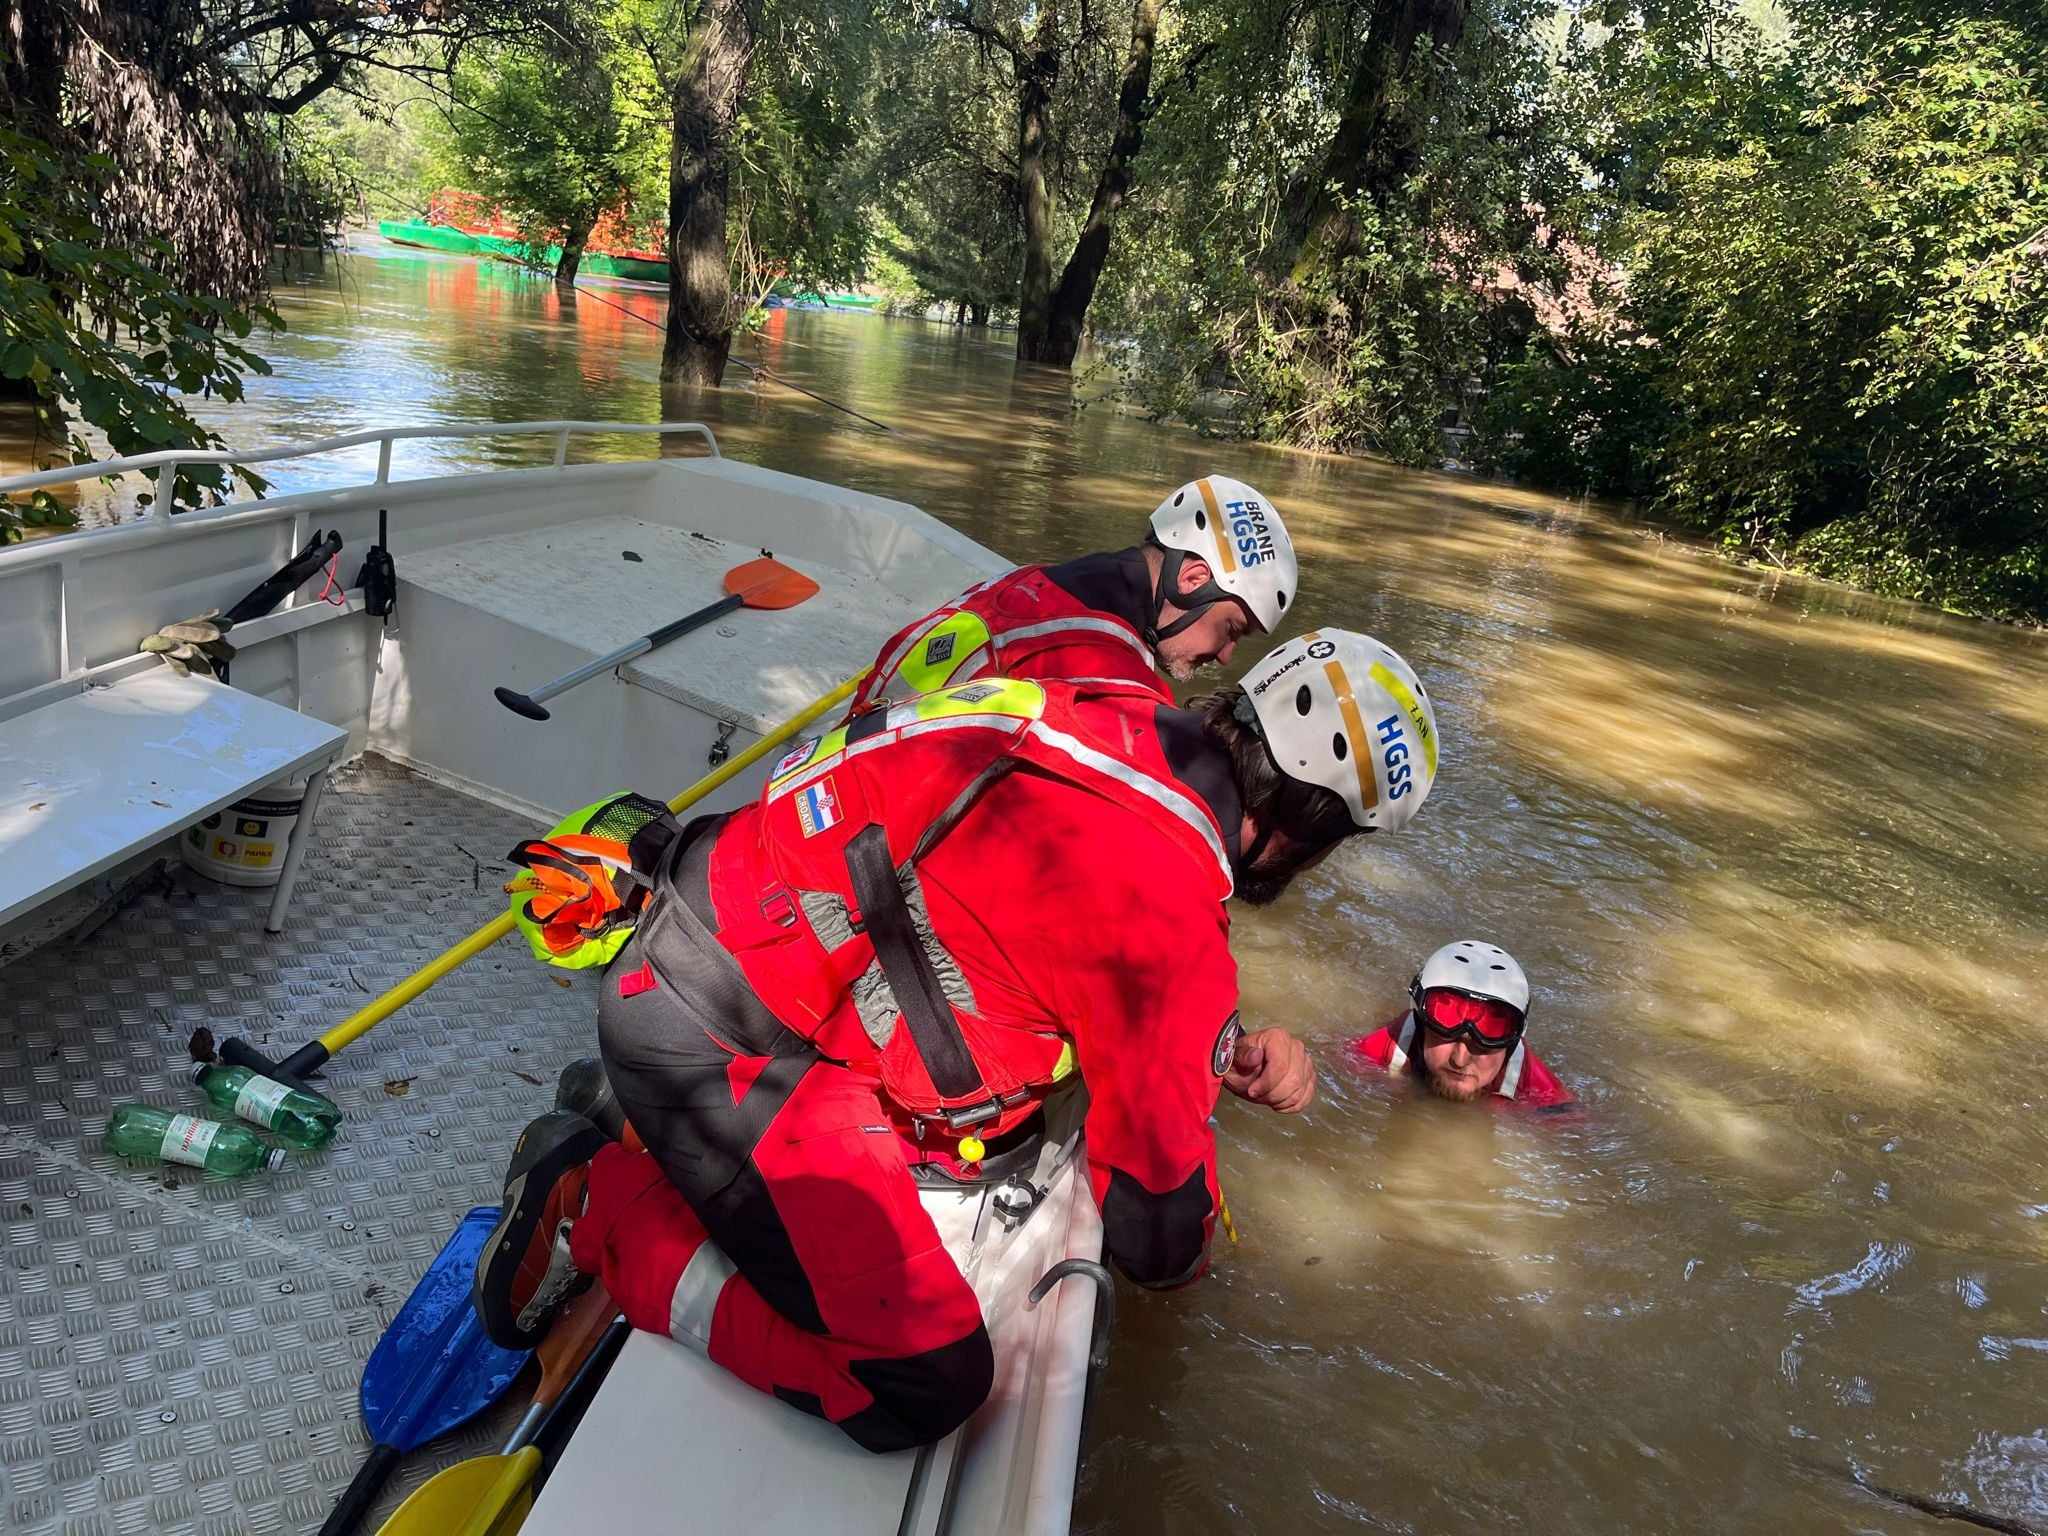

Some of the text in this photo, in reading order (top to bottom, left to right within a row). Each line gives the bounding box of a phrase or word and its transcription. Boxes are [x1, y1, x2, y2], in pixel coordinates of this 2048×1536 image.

[1226, 502, 1261, 567] HGSS
[1245, 501, 1275, 562] BRANE
[1376, 714, 1412, 800] HGSS
[798, 796, 814, 833] CROATIA
